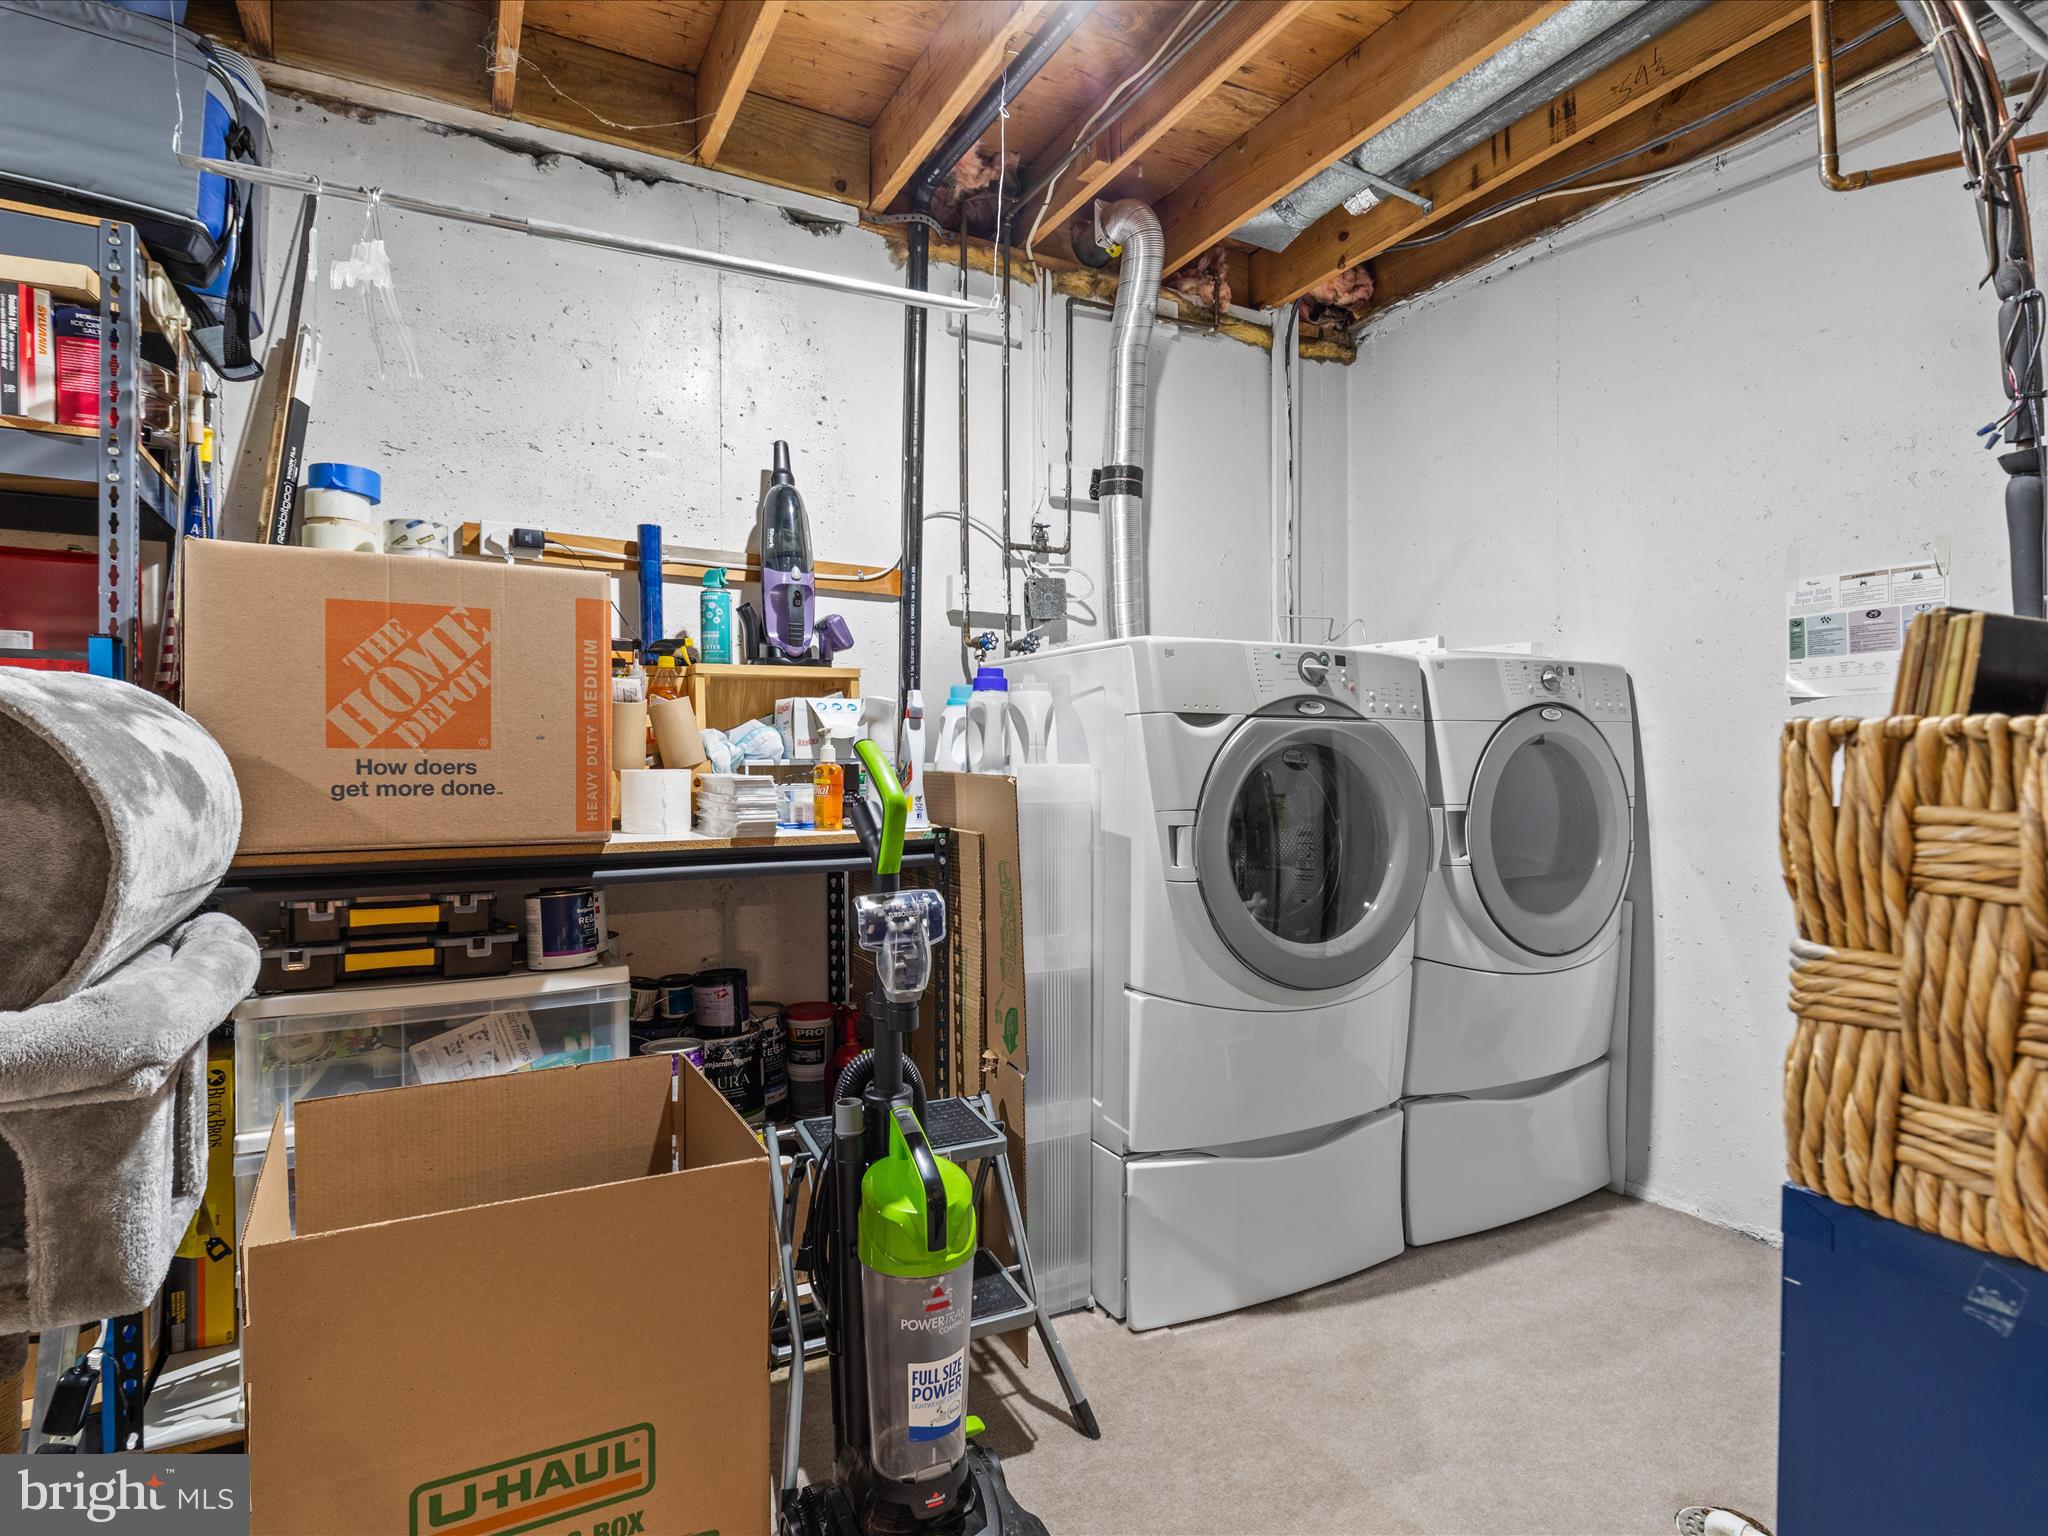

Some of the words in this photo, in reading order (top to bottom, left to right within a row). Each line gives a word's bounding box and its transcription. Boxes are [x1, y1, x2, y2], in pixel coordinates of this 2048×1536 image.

[37, 304, 48, 357] SYLVANIA
[276, 483, 293, 545] rabbitgoo
[341, 617, 415, 675] THE
[325, 606, 492, 749] HOME
[583, 639, 598, 718] MEDIUM
[393, 659, 491, 748] DEPOT
[355, 758, 408, 776] How
[414, 758, 477, 776] doers
[586, 724, 598, 766] DUTY
[330, 780, 369, 801] get
[376, 783, 435, 797] more
[586, 771, 598, 822] HEAVY
[796, 1027, 824, 1037] PRO
[207, 1086, 226, 1120] BUCK
[912, 1368, 939, 1386] FULL
[943, 1356, 962, 1381] SIZE
[912, 1373, 962, 1402] POWER
[428, 1441, 640, 1528] U-HAUL
[593, 1510, 644, 1536] BOX
